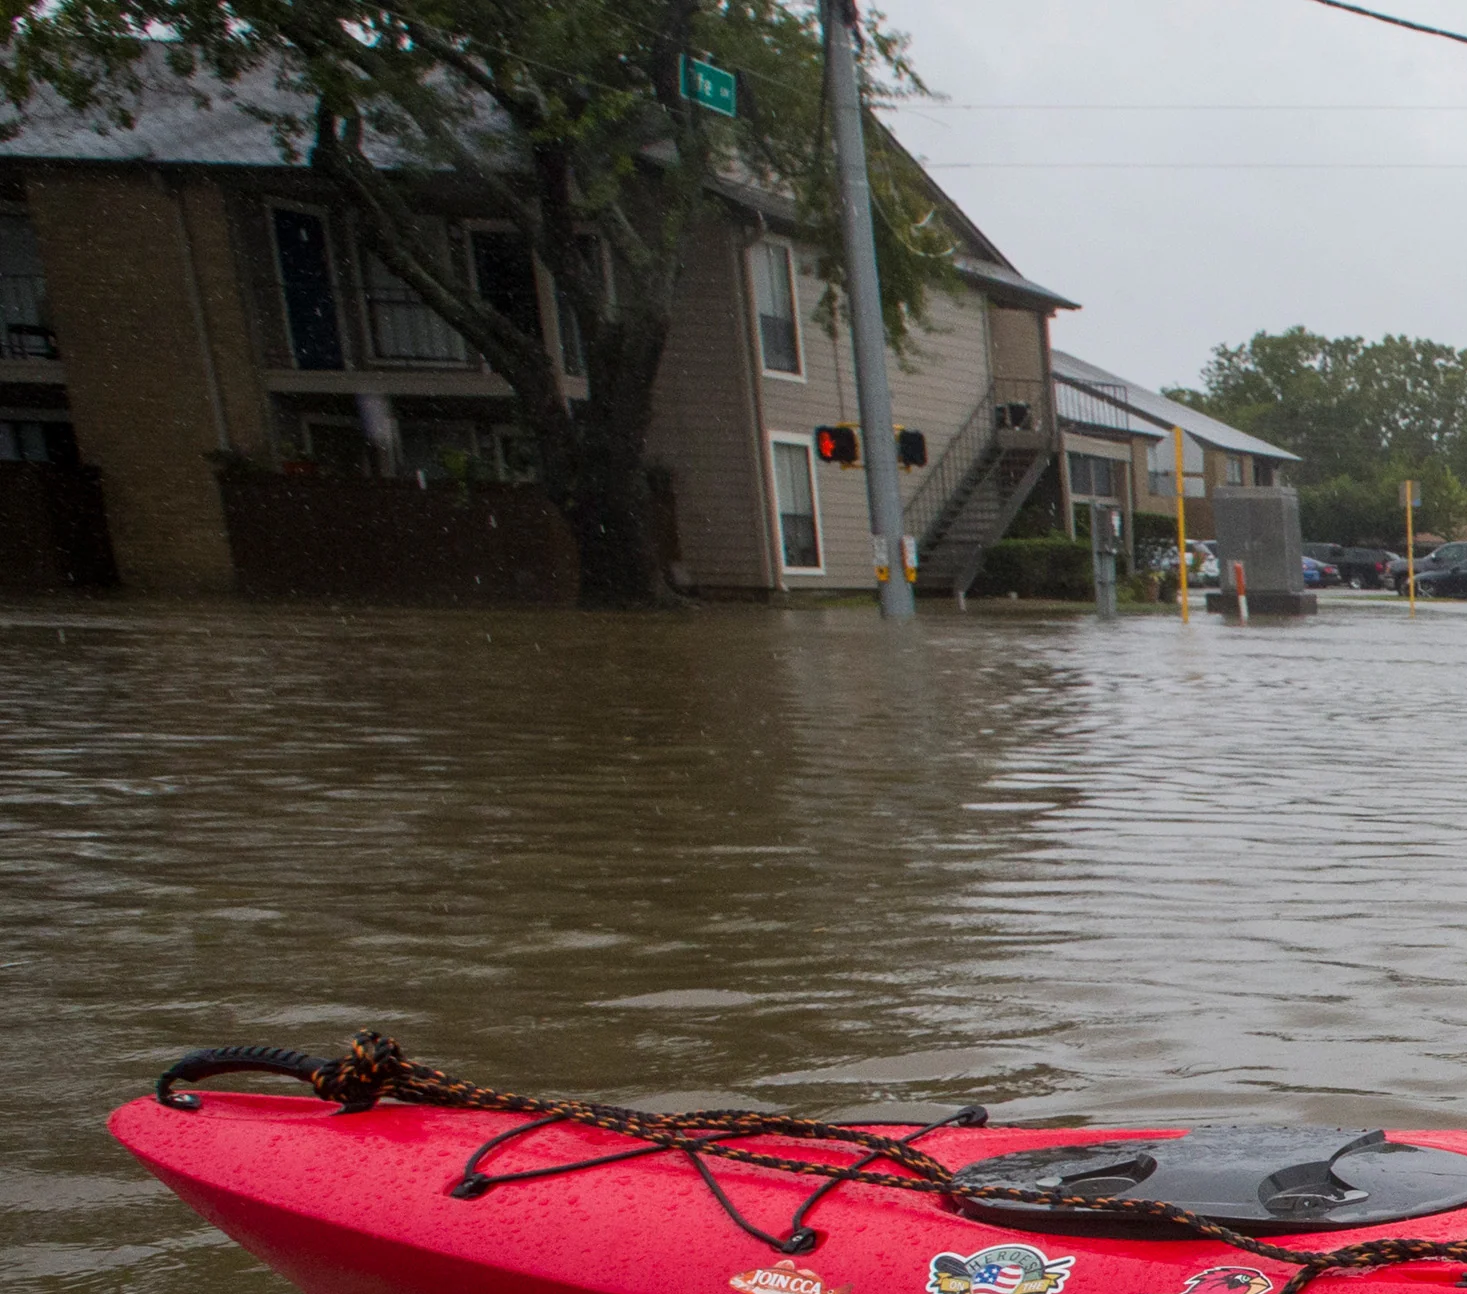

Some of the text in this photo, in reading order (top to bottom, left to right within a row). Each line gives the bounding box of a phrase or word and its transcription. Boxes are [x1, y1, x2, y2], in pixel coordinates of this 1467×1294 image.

[969, 1250, 1038, 1273] HEROES
[747, 1269, 791, 1288] JOIN
[949, 1281, 1043, 1292] ON THE
